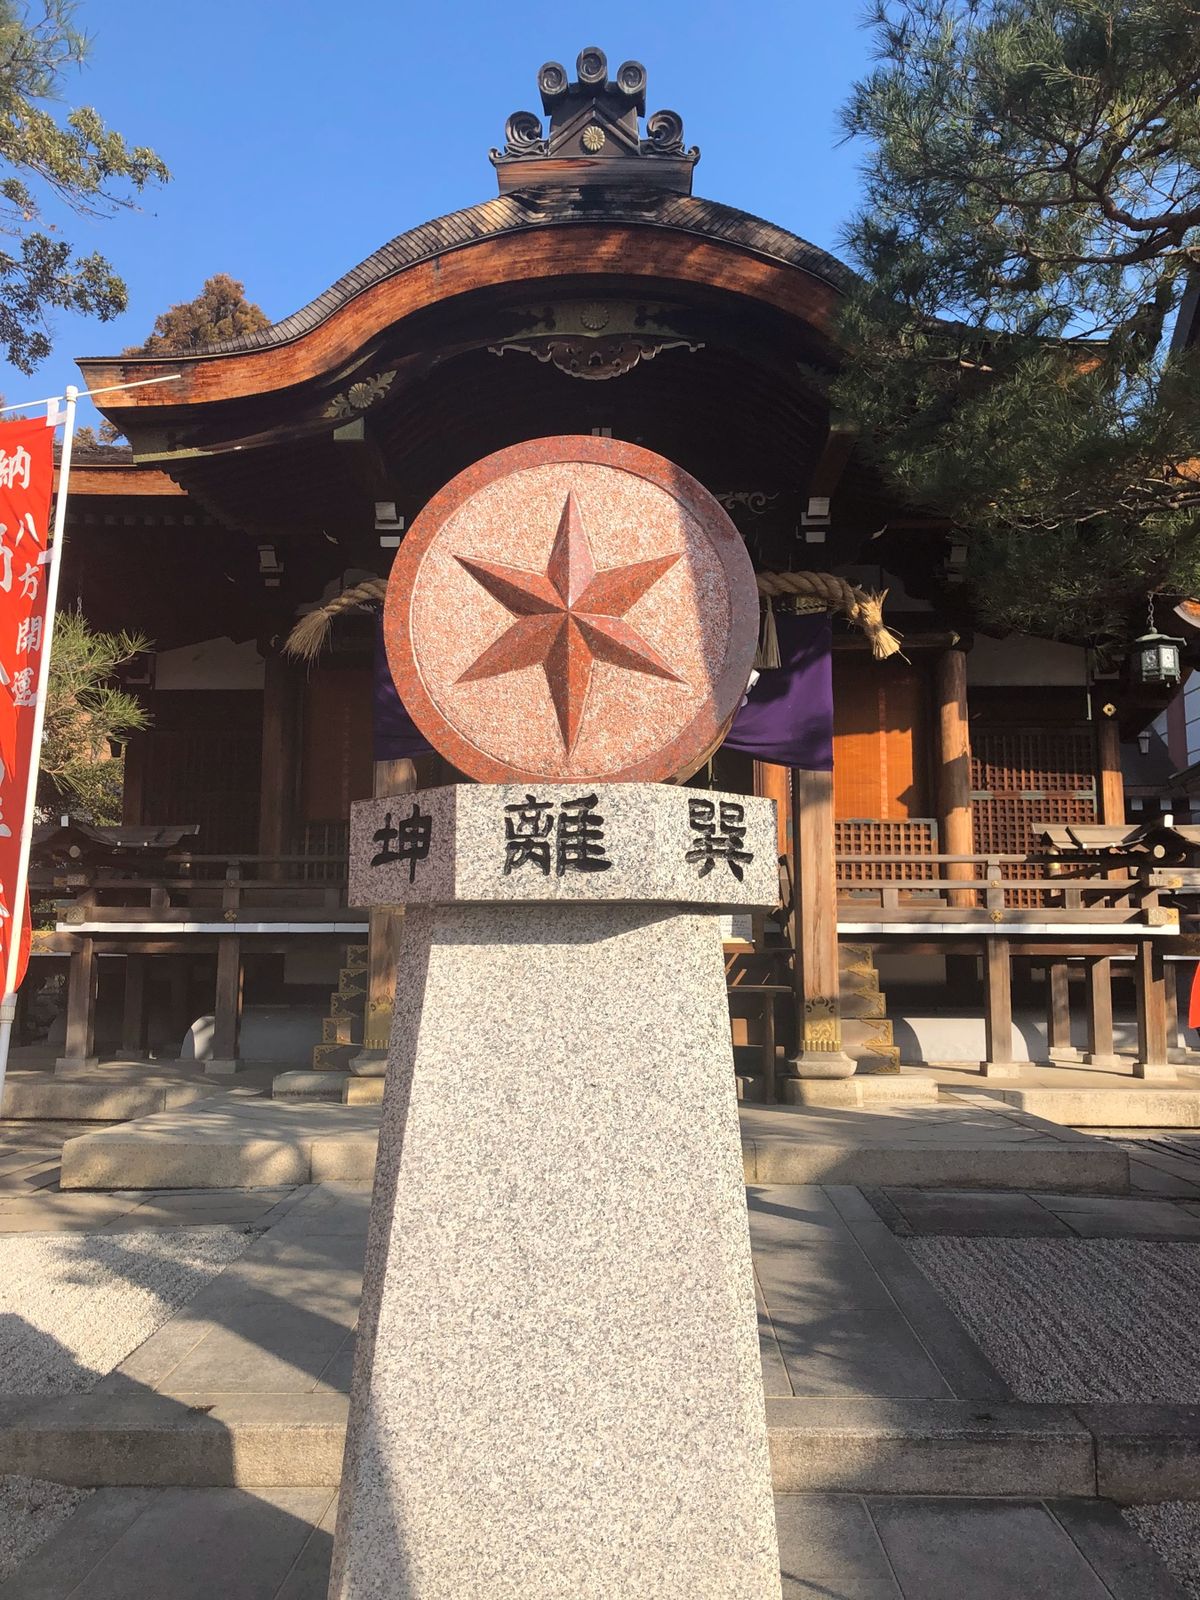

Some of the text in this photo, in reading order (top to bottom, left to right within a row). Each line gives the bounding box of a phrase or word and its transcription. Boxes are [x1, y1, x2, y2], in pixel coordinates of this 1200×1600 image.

[11, 512, 43, 707] 八方開運
[371, 803, 433, 884] 坤
[503, 793, 612, 877] 離
